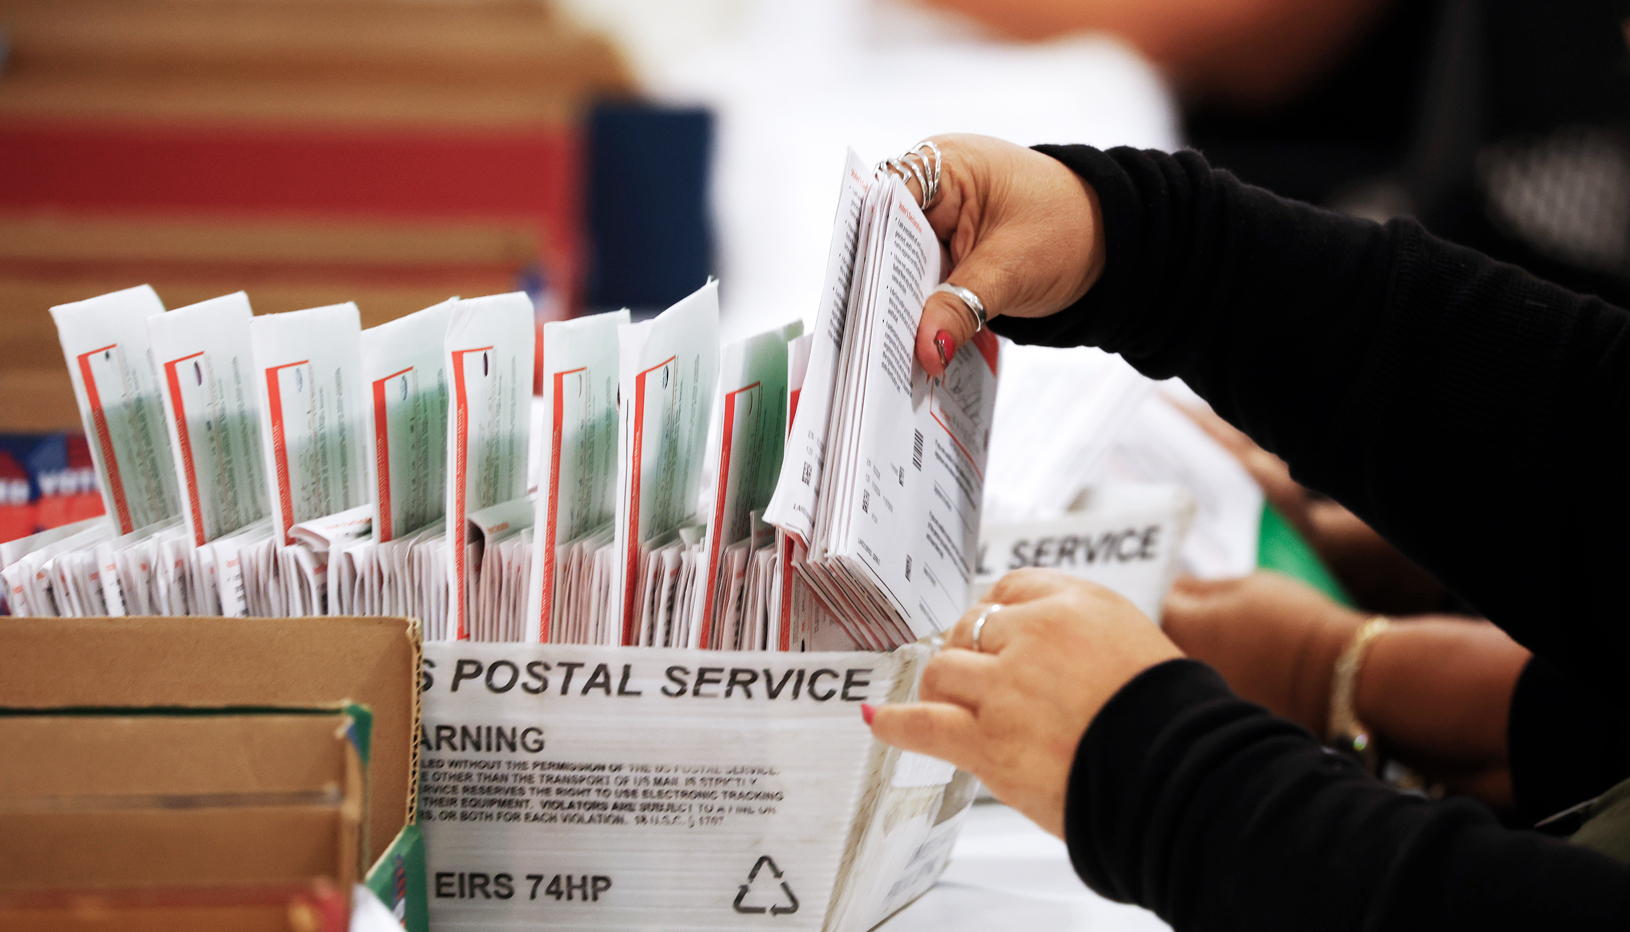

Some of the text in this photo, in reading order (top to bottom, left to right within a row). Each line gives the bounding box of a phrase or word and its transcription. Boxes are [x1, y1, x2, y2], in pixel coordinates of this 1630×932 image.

[1009, 523, 1161, 571] SERVICE
[450, 658, 643, 697] POSTAL
[660, 665, 874, 702] SERVICE
[448, 759, 502, 770] WITHOUT
[505, 760, 529, 770] THE
[532, 761, 606, 772] PERMISSION
[608, 764, 624, 772] OF
[629, 764, 651, 773] THE
[431, 772, 473, 782] OTHER
[476, 773, 509, 783] THAN
[512, 773, 536, 784] THE
[539, 774, 610, 785] TRANSPORT
[613, 776, 630, 786] OF
[633, 776, 650, 786] US
[461, 785, 526, 796] RESERVES
[529, 786, 552, 797] THE
[555, 787, 592, 798] RIGHT
[595, 788, 612, 798] TO
[614, 788, 639, 799] USE
[641, 789, 718, 800] ELECTRONIC
[721, 790, 785, 801] TRACKING
[422, 797, 458, 808] THEIR
[539, 800, 608, 811] VIOLATORS
[611, 801, 636, 812] ARE
[639, 802, 692, 812] SUBJECT
[698, 803, 714, 813] TO
[438, 810, 457, 821] OR
[459, 811, 494, 822] BOTH
[495, 811, 521, 822] FOR
[524, 812, 557, 823] EACH
[435, 871, 612, 902] EIRS 74HP
